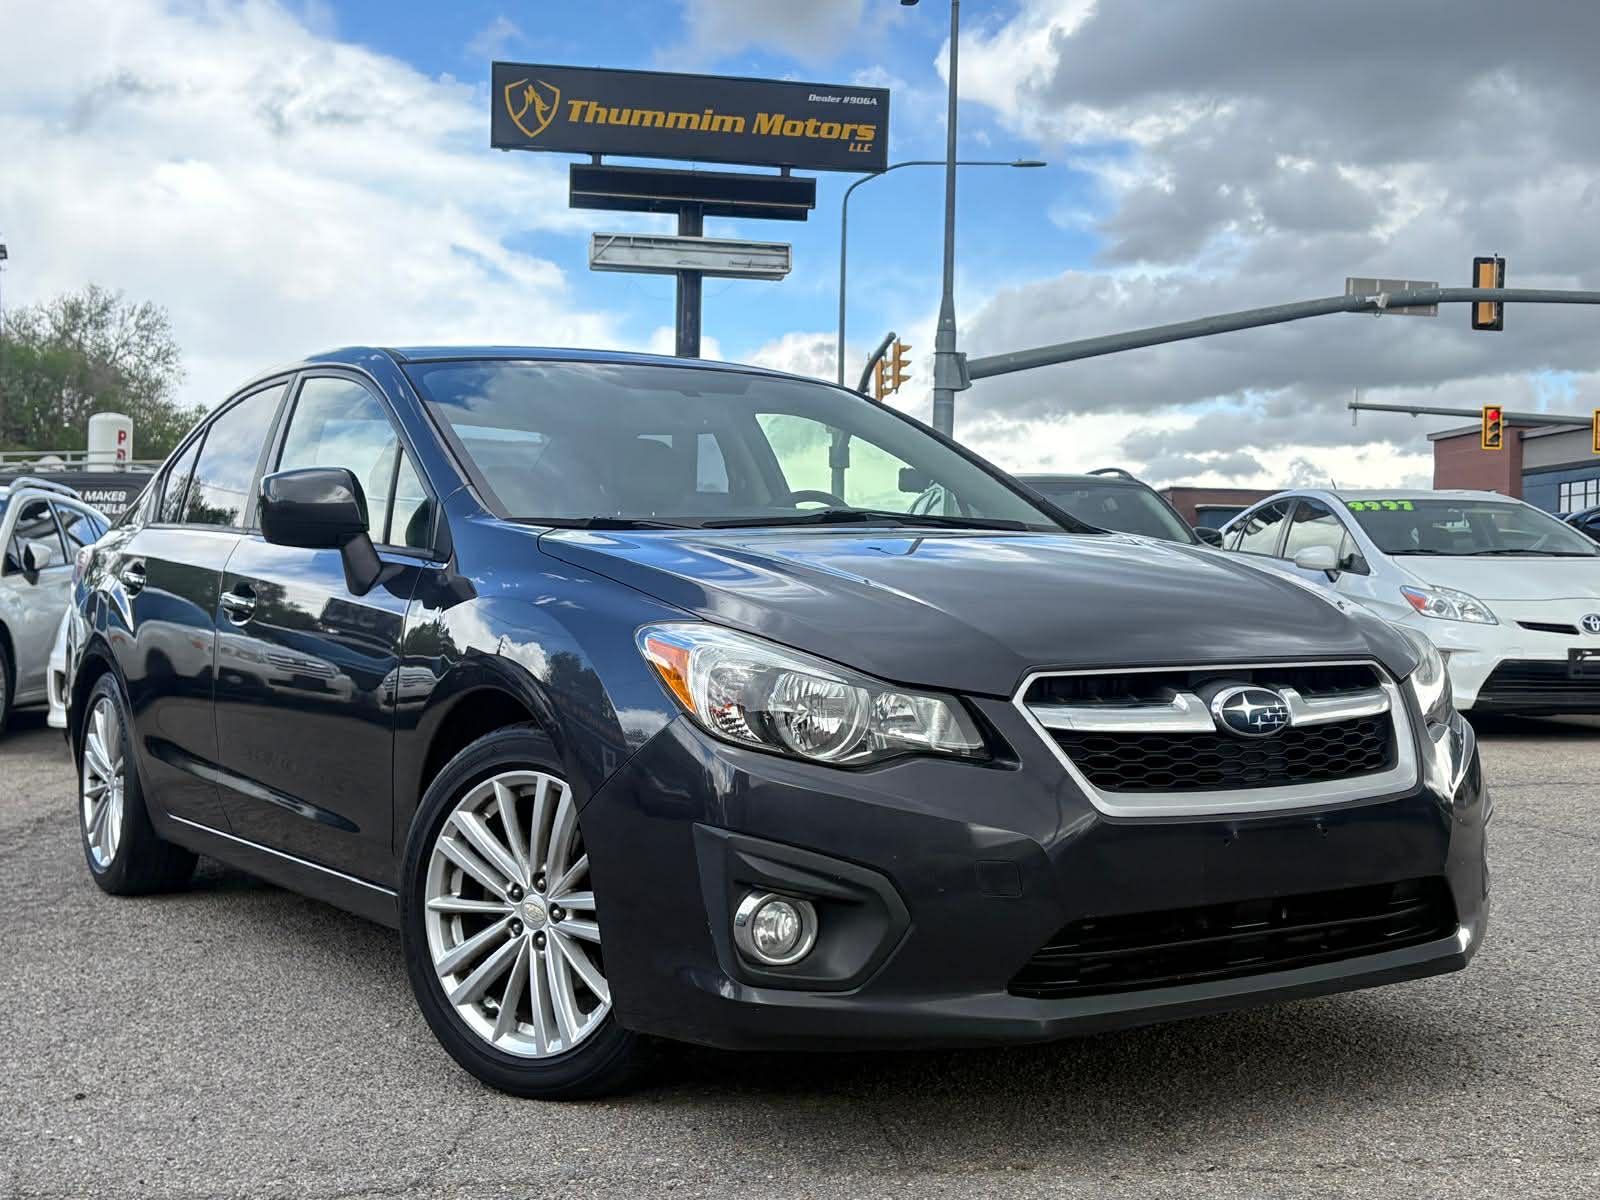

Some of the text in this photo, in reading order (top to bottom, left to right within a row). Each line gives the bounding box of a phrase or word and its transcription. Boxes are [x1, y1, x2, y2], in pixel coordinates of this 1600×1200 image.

[808, 94, 878, 106] Dealer #906A
[568, 100, 876, 141] Thummim Motors
[848, 143, 872, 153] LLC
